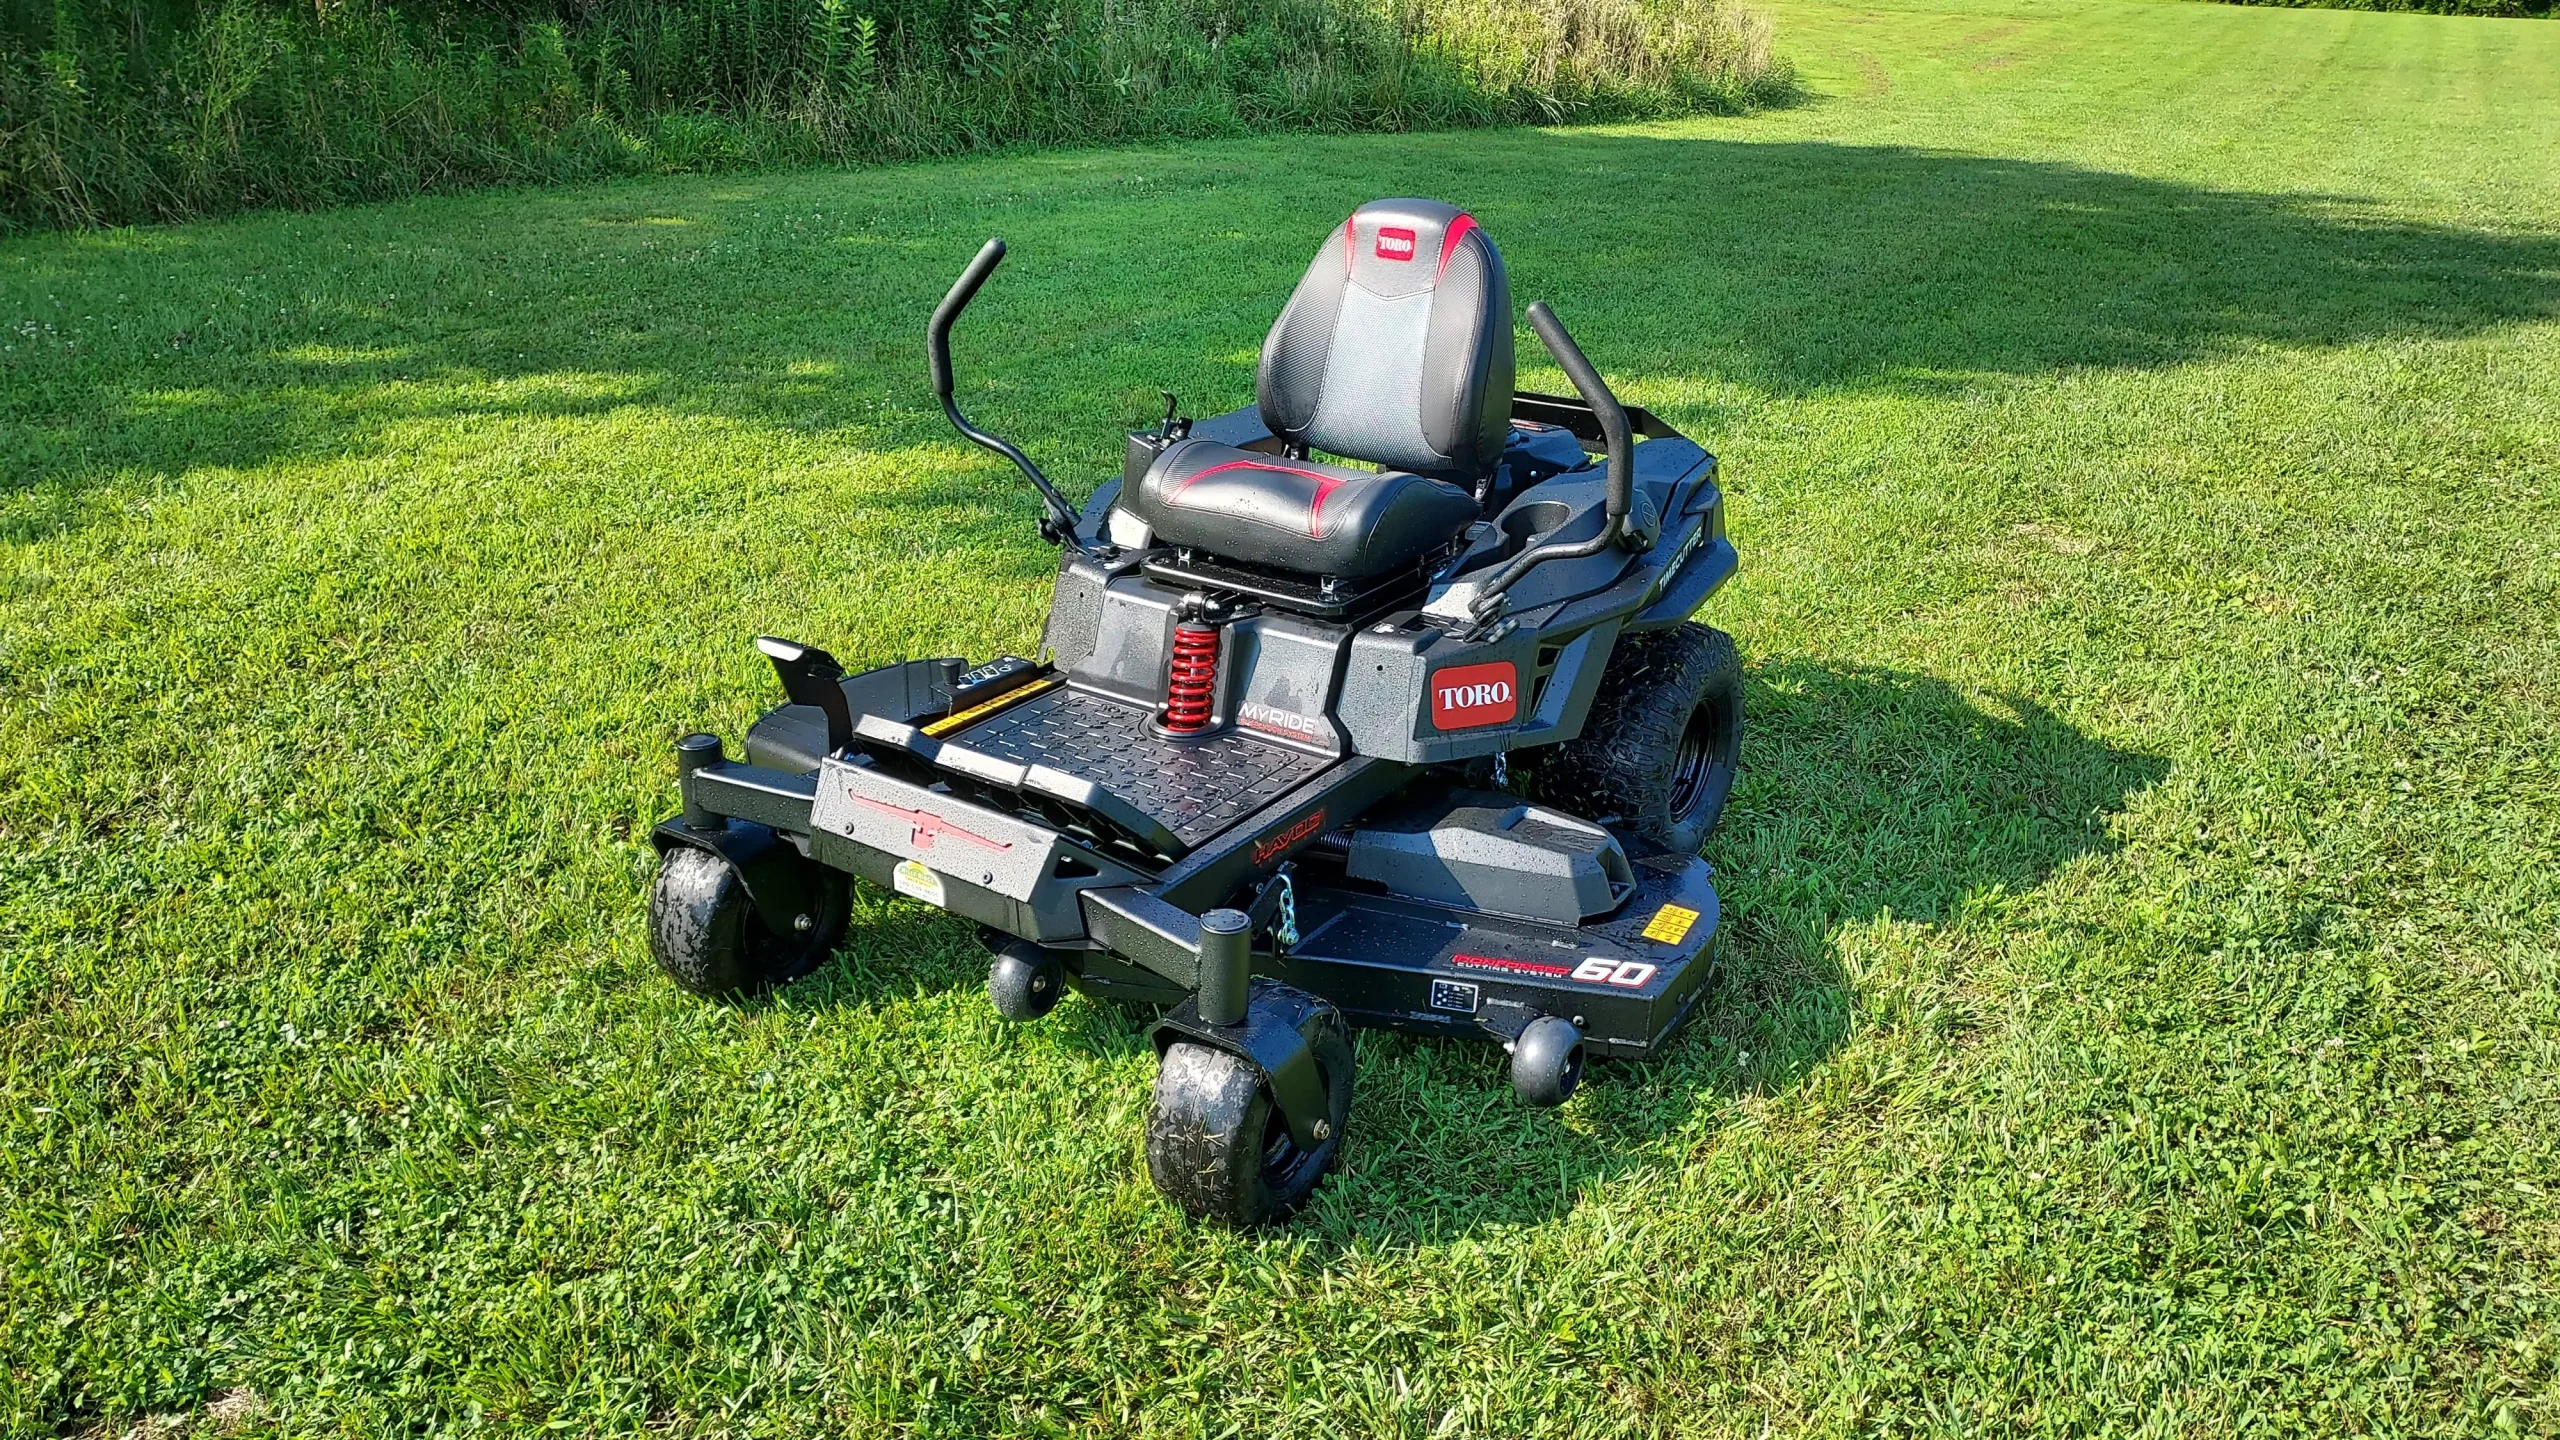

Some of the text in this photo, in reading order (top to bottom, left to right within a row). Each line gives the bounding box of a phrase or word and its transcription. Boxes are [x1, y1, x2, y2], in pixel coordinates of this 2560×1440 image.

[1378, 236, 1411, 253] TORO
[1658, 526, 1702, 592] TIMECUTTER
[1438, 681, 1511, 711] TORO
[1253, 808, 1325, 865] HAVOC
[1452, 953, 1658, 988] IRONFORGED 60
[1457, 962, 1562, 979] CUTTING SYSTEM
